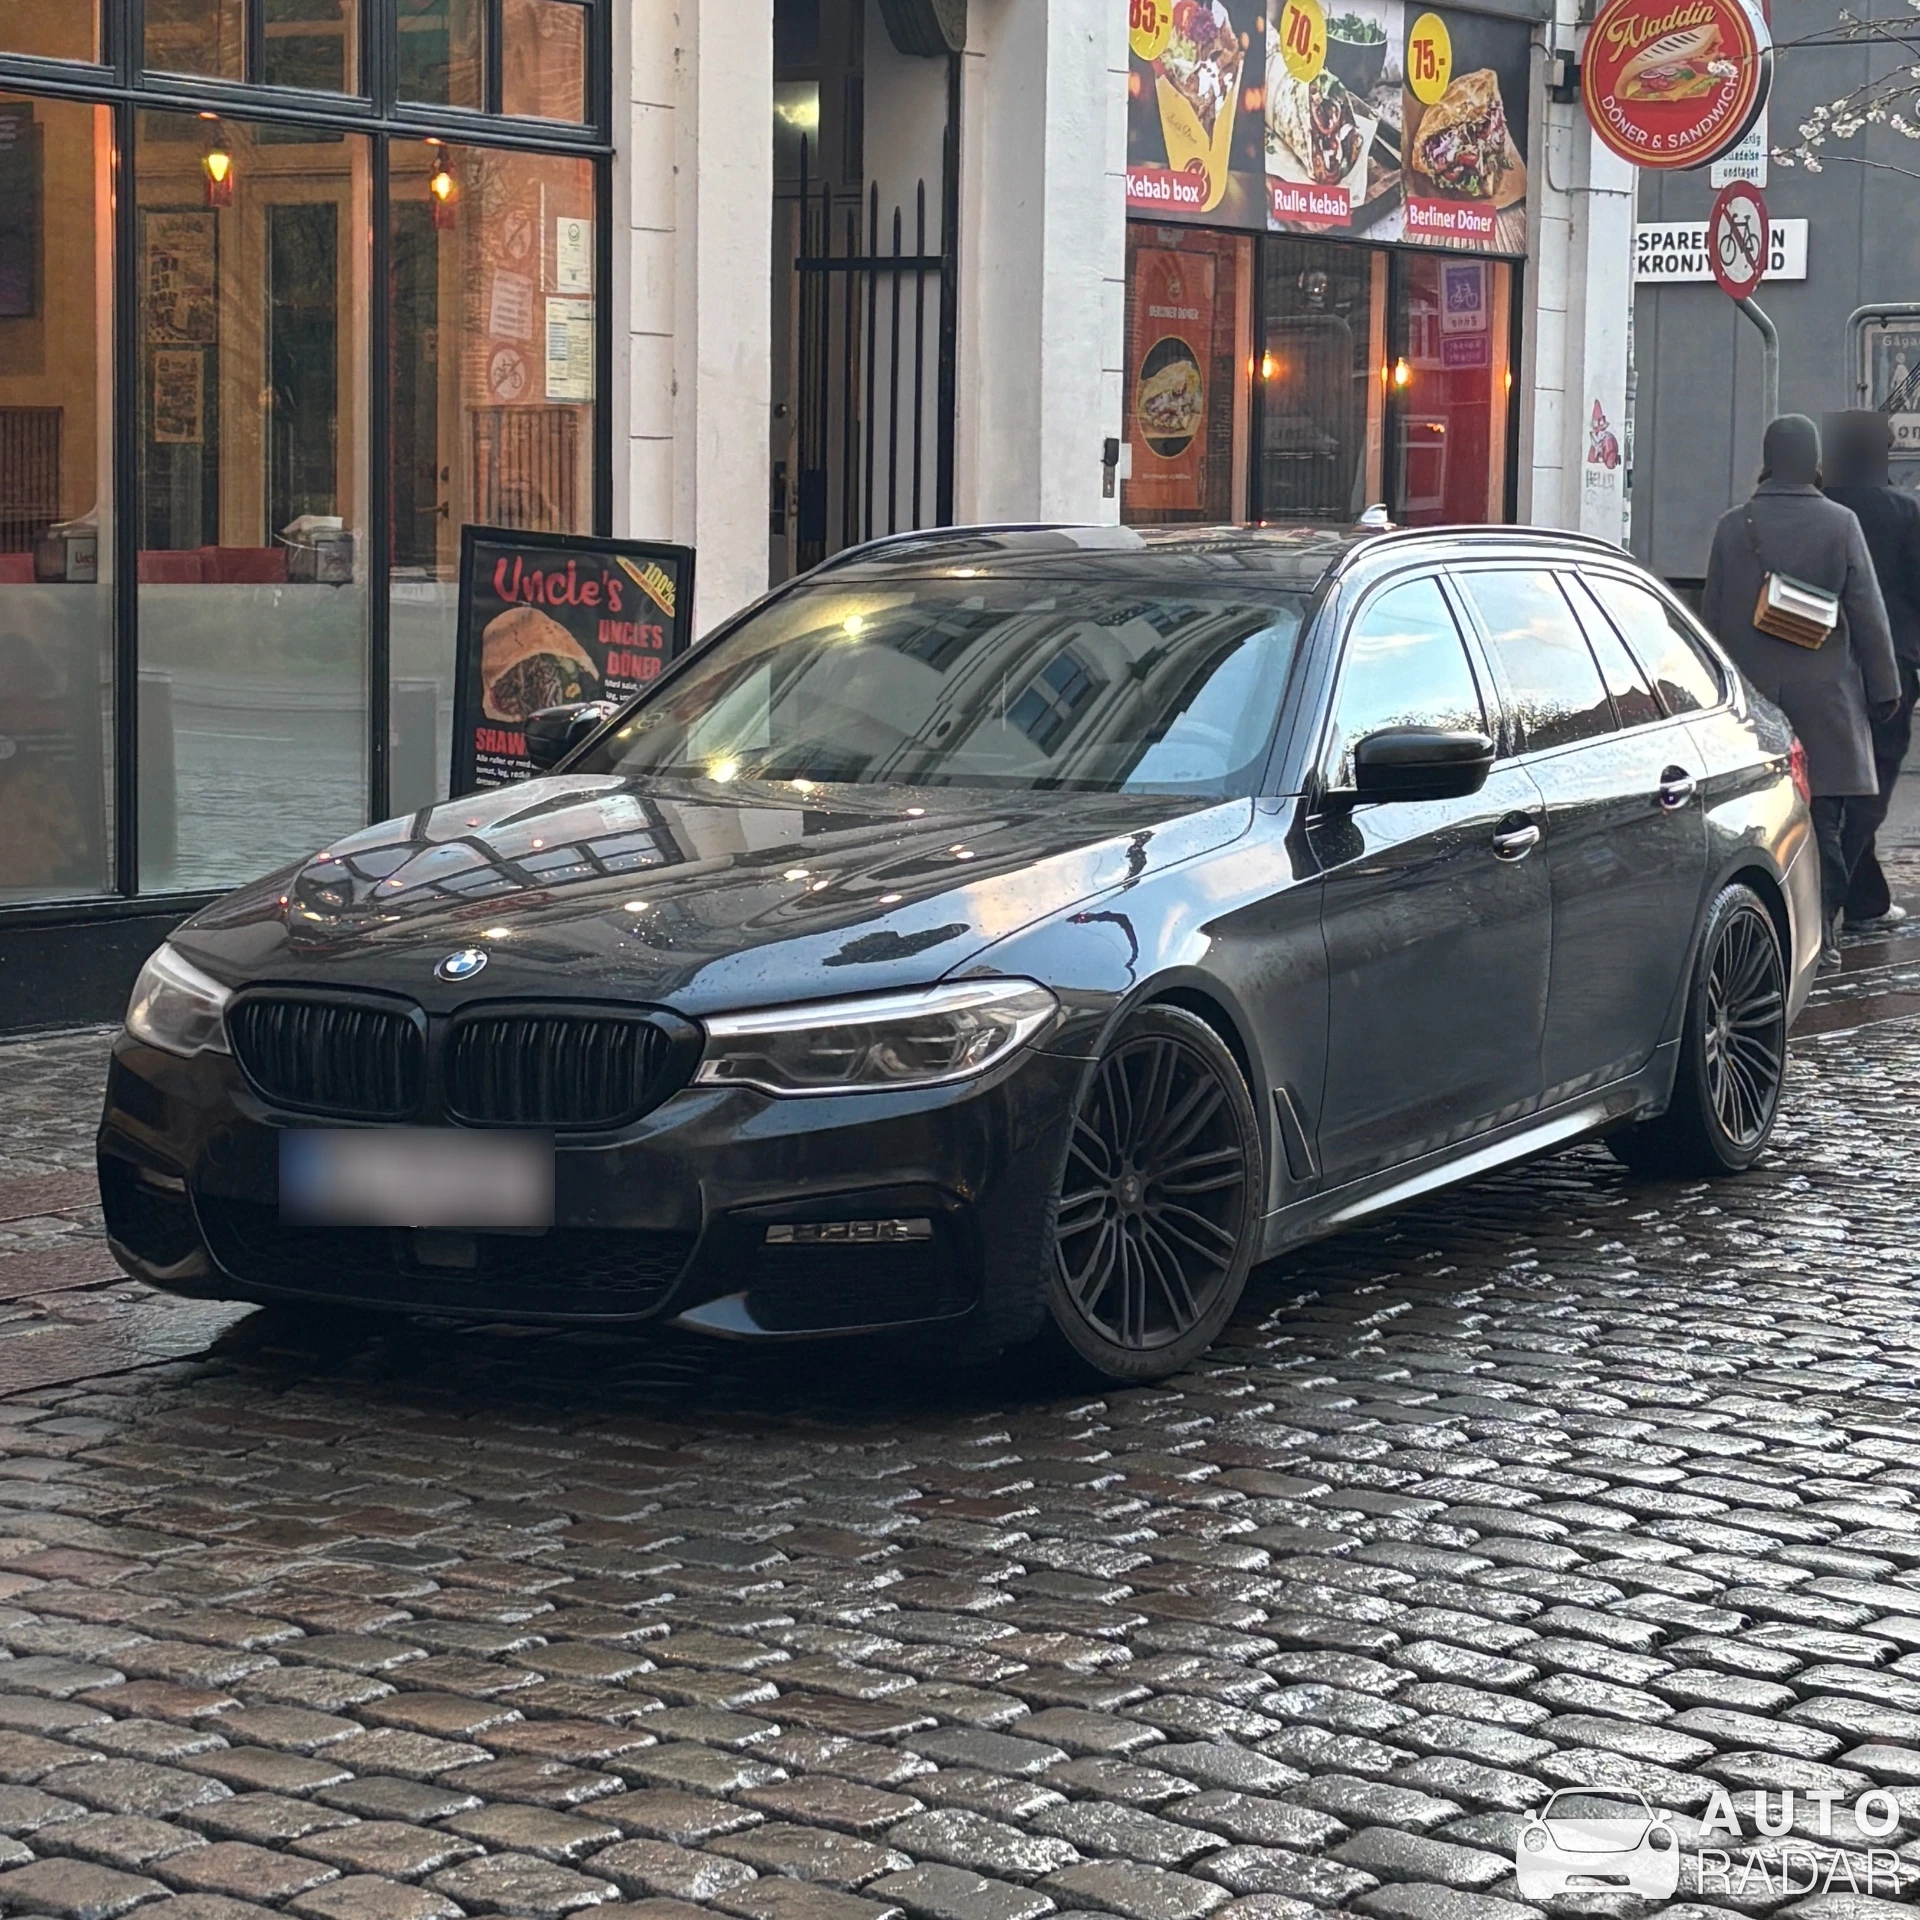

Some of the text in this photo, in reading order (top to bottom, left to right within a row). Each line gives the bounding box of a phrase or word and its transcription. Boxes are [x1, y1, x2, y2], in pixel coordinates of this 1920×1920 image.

[1287, 5, 1320, 64] 70,-
[1606, 1, 1717, 62] Aladdin
[1413, 39, 1445, 83] 75,-
[1602, 73, 1738, 148] DÖNER & SANDWICH
[1126, 175, 1200, 203] Kebab box
[1274, 188, 1348, 216] Rulle kebab
[1410, 204, 1493, 232] Berliner Döner
[1638, 229, 1785, 251] SPAREN
[1638, 252, 1785, 273] KRONJYD
[1882, 334, 1920, 349] Gåga
[493, 555, 623, 612] Uncle's
[643, 562, 676, 605] 100%
[476, 727, 528, 756] SHAW
